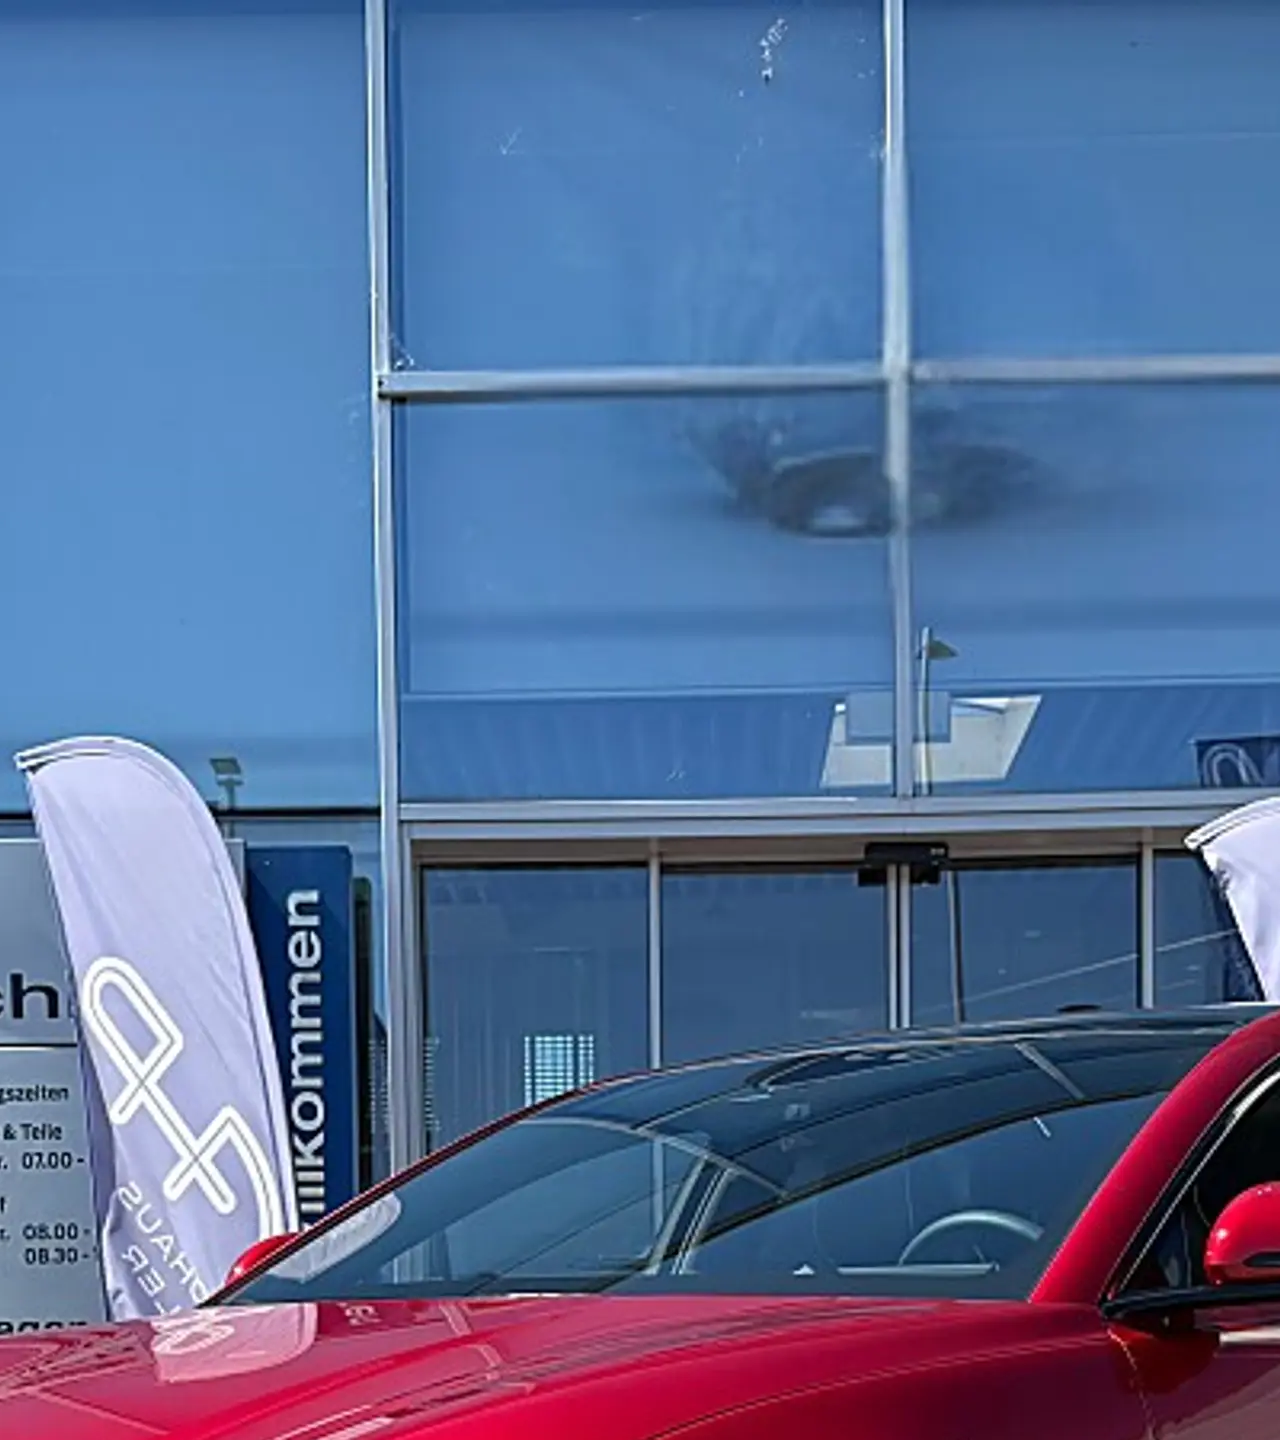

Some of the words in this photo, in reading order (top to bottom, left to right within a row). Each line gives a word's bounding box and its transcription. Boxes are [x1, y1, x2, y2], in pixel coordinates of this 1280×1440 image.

[287, 888, 326, 1232] illkommen
[2, 1123, 17, 1141] &
[20, 1122, 62, 1141] Teile
[21, 1152, 72, 1170] 07.00
